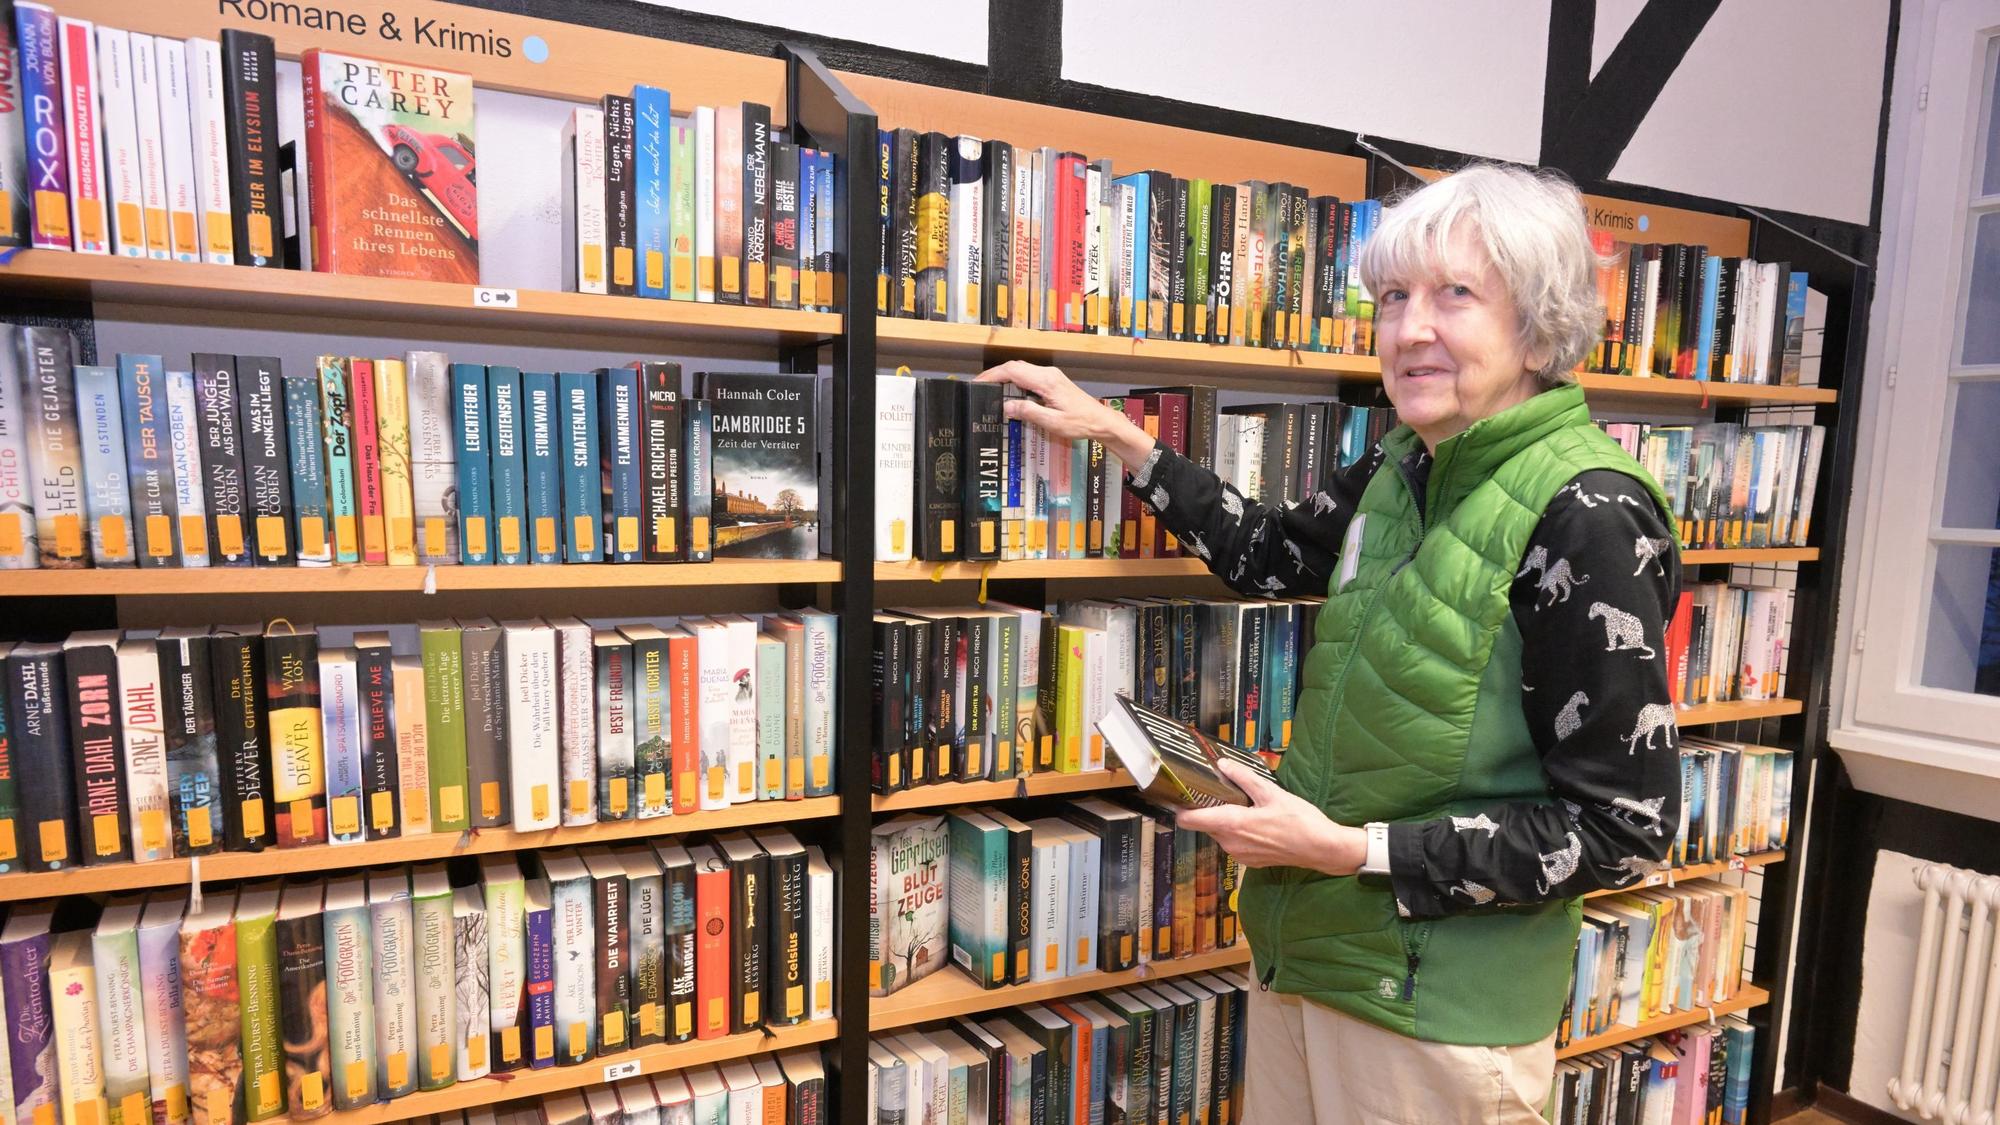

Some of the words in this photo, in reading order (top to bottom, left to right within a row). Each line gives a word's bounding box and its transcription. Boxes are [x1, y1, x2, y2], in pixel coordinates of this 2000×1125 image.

[217, 0, 366, 35] Romane
[379, 12, 402, 41] &
[414, 17, 512, 58] Krimis
[24, 24, 37, 72] JOHANN
[44, 61, 56, 85] VON
[343, 62, 450, 98] PETER
[76, 85, 87, 139] ROULETTE
[341, 84, 454, 119] CAREY
[610, 99, 621, 138] Nichts
[245, 91, 261, 152] ELYSIUM
[622, 103, 633, 139] Lügen
[33, 95, 59, 187] ROX
[623, 144, 633, 160] als
[248, 160, 263, 175] IM
[612, 142, 622, 182] Lügen.
[756, 122, 766, 205] NEBELMANN
[881, 143, 889, 180] KIND
[388, 193, 417, 208] Das
[1001, 163, 1009, 212] PASSAGIER
[362, 207, 444, 228] schnellste
[373, 224, 434, 242] Rennen
[776, 222, 785, 246] CHRIS
[785, 218, 796, 250] CARTER
[1198, 204, 1208, 256] Herzschuss
[1221, 197, 1231, 248] EISENBERG
[1594, 209, 1634, 231] Krimis
[352, 237, 395, 255] ihres
[399, 242, 456, 260] Lebens
[749, 226, 757, 260] DONATO
[1014, 221, 1024, 286] SEBASTIAN
[1177, 231, 1185, 263] Unterm
[1090, 244, 1098, 281] FITZEK
[1217, 251, 1232, 307] FÖHR
[480, 292, 490, 303] C
[38, 347, 60, 421] GEJAGTEN
[135, 364, 152, 424] TAUSCH
[216, 370, 231, 409] WALD
[250, 394, 259, 407] IM
[259, 370, 271, 402] LIEGT
[650, 391, 676, 402] MICRO
[716, 388, 763, 401] Hannah
[766, 389, 801, 401] Coler
[94, 394, 109, 441] STUNDEN
[204, 379, 218, 425] JUNGE
[328, 391, 344, 426] Zopf
[463, 383, 480, 451] LEUCHTFEUER
[880, 411, 912, 422] FOLLETT
[891, 404, 905, 412] KEN
[171, 405, 185, 451] COBEN
[208, 427, 220, 447] DER
[222, 412, 232, 434] DEM
[251, 409, 262, 433] WAS
[262, 403, 276, 457] DUNKELN
[497, 384, 515, 456] GEZEITENSPIEL
[533, 390, 550, 456] STURMWAND
[571, 388, 587, 467] SCHATTENLAND
[616, 384, 630, 465] FLAMMENMEER
[712, 415, 791, 434] CAMBRIDGE
[797, 418, 805, 434] 5
[46, 427, 64, 451] DIE
[141, 427, 157, 459] DER
[222, 436, 234, 456] AUS
[332, 429, 347, 457] Der
[365, 445, 373, 460] Das
[651, 419, 665, 468] CRICHTON
[717, 438, 739, 449] Zeit
[741, 439, 757, 449] der
[761, 439, 800, 450] Verräter
[146, 469, 159, 497] CLARK
[175, 454, 190, 505] HARLAN
[212, 464, 227, 516] HARLAN
[254, 465, 269, 516] HARLAN
[338, 468, 347, 504] Colombani
[693, 458, 701, 496] DEBORAH
[979, 447, 999, 499] NEVER
[43, 477, 60, 512] LEE
[225, 469, 240, 514] COBEN
[267, 469, 281, 514] COBEN
[367, 484, 375, 498] der
[652, 471, 667, 536] MICHAEL
[439, 651, 449, 673] Tage
[530, 652, 539, 668] den
[680, 649, 690, 670] Meer
[1253, 616, 1261, 678] GALBRAITH
[22, 662, 37, 700] DAHL
[282, 653, 293, 690] WAHL
[293, 659, 304, 682] LOS
[370, 666, 381, 684] ME
[470, 651, 479, 681] Dicker
[482, 650, 491, 711] Verschwinden
[519, 653, 529, 684] Dicker
[646, 650, 660, 693] TOCHTER
[39, 662, 52, 714] Bußestunde
[78, 674, 112, 727] ZORN
[182, 673, 195, 715] TÄUSCHER
[231, 678, 241, 699] DER
[241, 646, 255, 728] GIFTZEICHNER
[541, 689, 553, 714] Harry
[681, 687, 690, 716] wieder
[28, 702, 42, 736] ARNE
[186, 716, 196, 734] DER
[370, 691, 385, 739] BELIEVE
[483, 713, 493, 731] Das
[541, 715, 551, 732] Fall
[610, 703, 624, 734] BESTE
[682, 717, 691, 744] Immer
[84, 736, 115, 773] DAHL
[285, 733, 296, 777] JEFFERY
[294, 720, 311, 785] DEAVER
[236, 751, 245, 795] JEFFERY
[89, 777, 119, 815] ARNE
[891, 834, 948, 875] Gerritsen
[904, 865, 938, 894] BLUT
[1021, 857, 1030, 889] GONE
[640, 888, 651, 910] LÜGE
[782, 873, 791, 912] MARC
[793, 863, 802, 919] ELSBERG
[897, 883, 943, 917] ZEUGE
[607, 881, 618, 947] WAHRHEIT
[642, 913, 652, 935] DIE
[1021, 901, 1029, 936] GOOD
[168, 957, 178, 983] Clara
[533, 934, 541, 979] SECHZEHN
[608, 947, 618, 968] DIE
[751, 944, 759, 988] ELSBERG
[788, 932, 798, 981] Celsius
[20, 1005, 30, 1022] Die
[169, 984, 179, 1009] Bella
[128, 1057, 138, 1071] DIE
[610, 1068, 617, 1077] E
